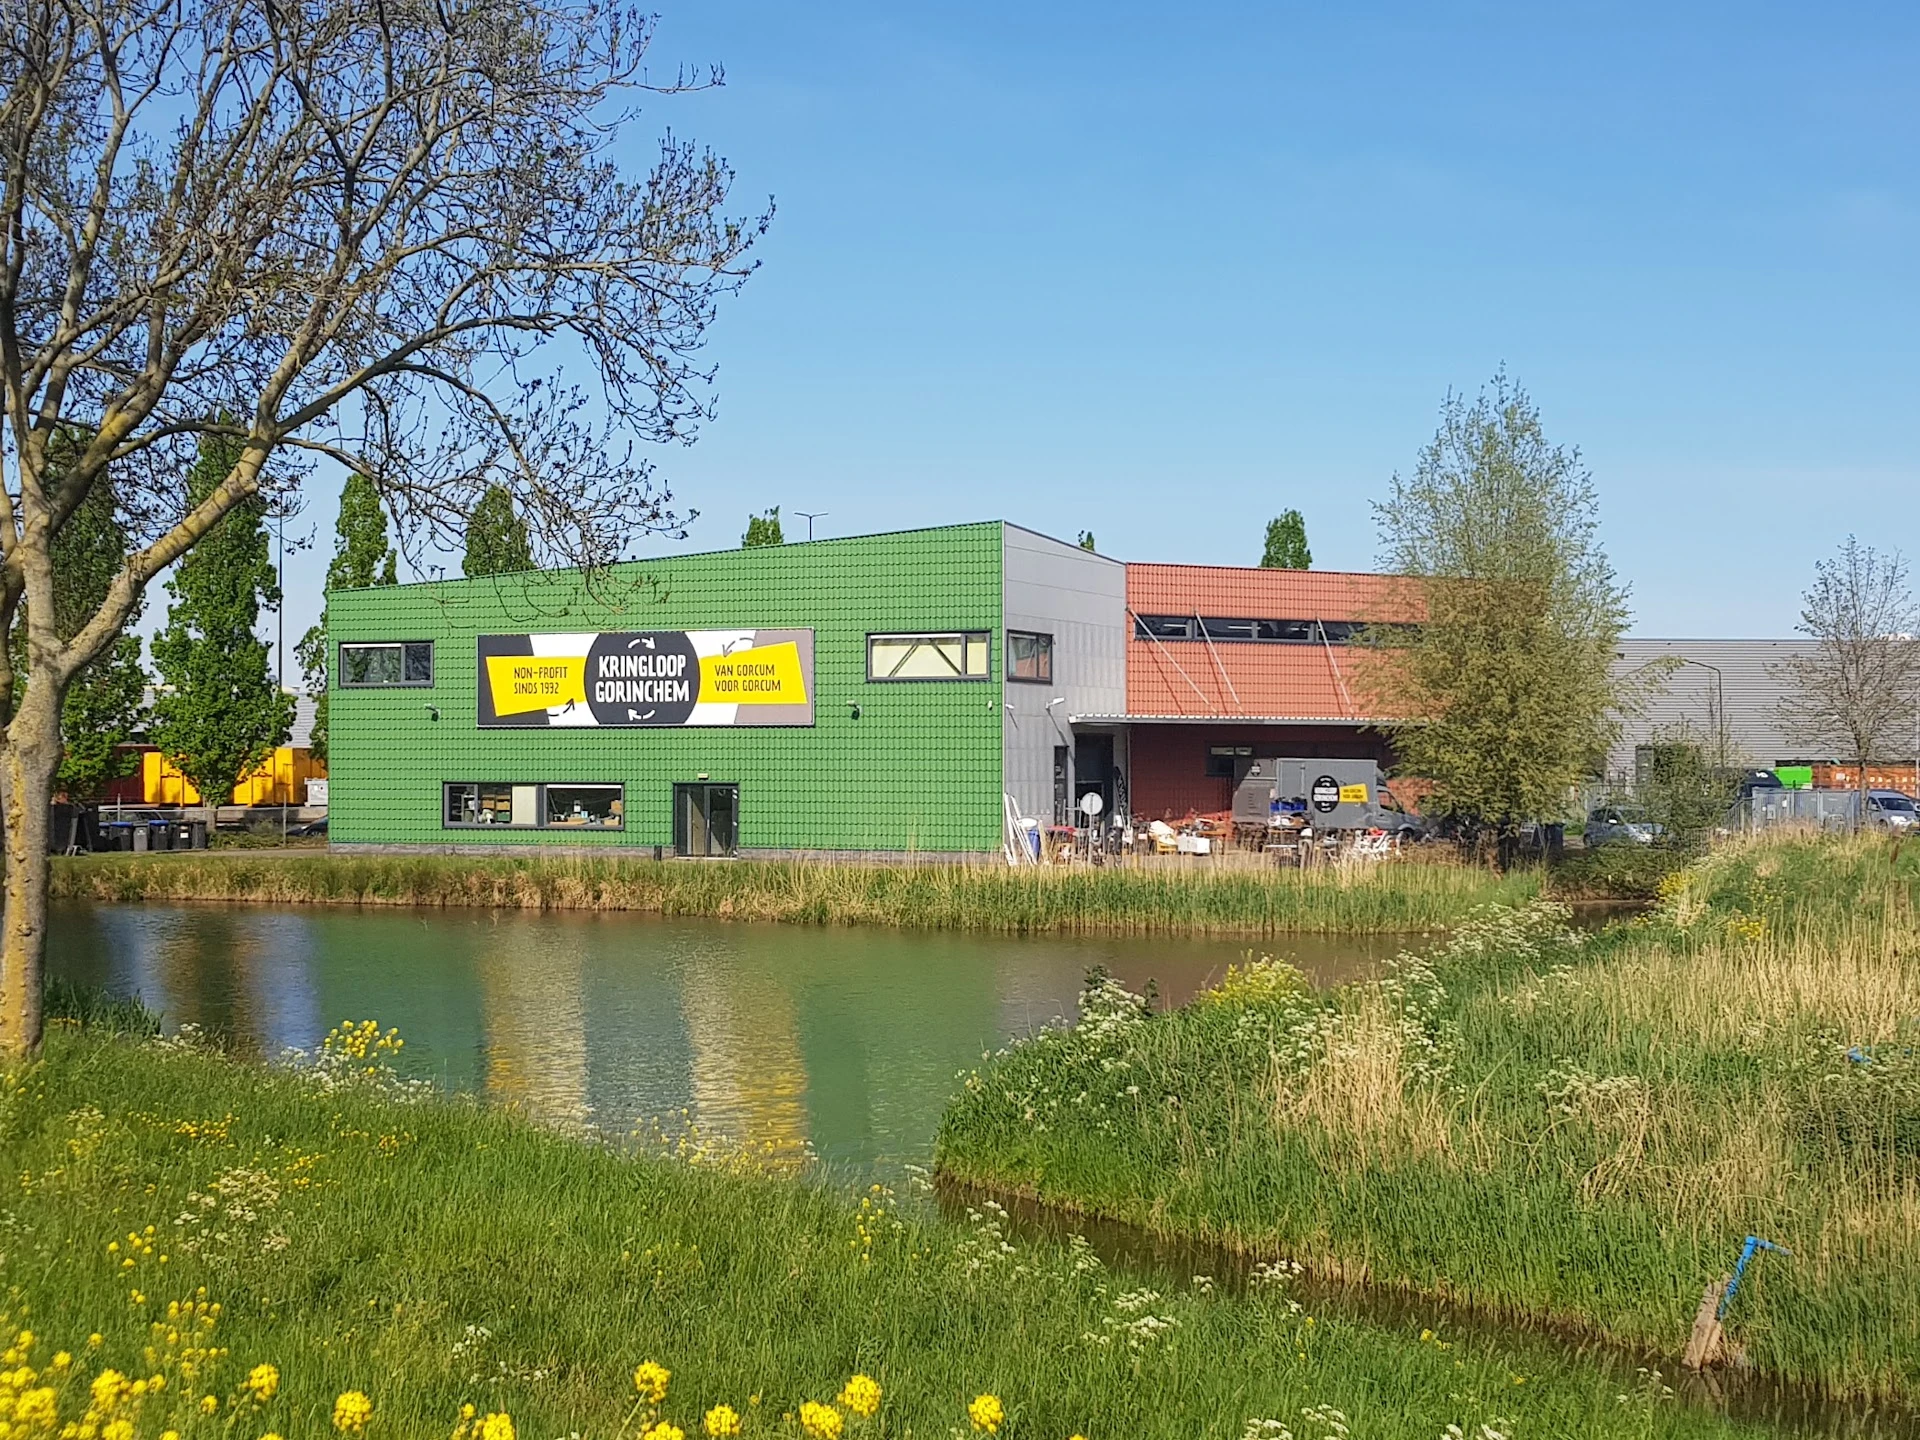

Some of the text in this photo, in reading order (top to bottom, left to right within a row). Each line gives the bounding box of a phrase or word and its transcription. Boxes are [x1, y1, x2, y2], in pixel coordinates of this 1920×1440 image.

[599, 654, 686, 677] KRINGLOOP
[714, 664, 775, 676] VAN GORCUM
[514, 666, 568, 679] NON-PROFIT
[514, 682, 538, 694] SINDS
[595, 680, 689, 703] GORINCHEM
[714, 679, 781, 692] VOOR GORCUM
